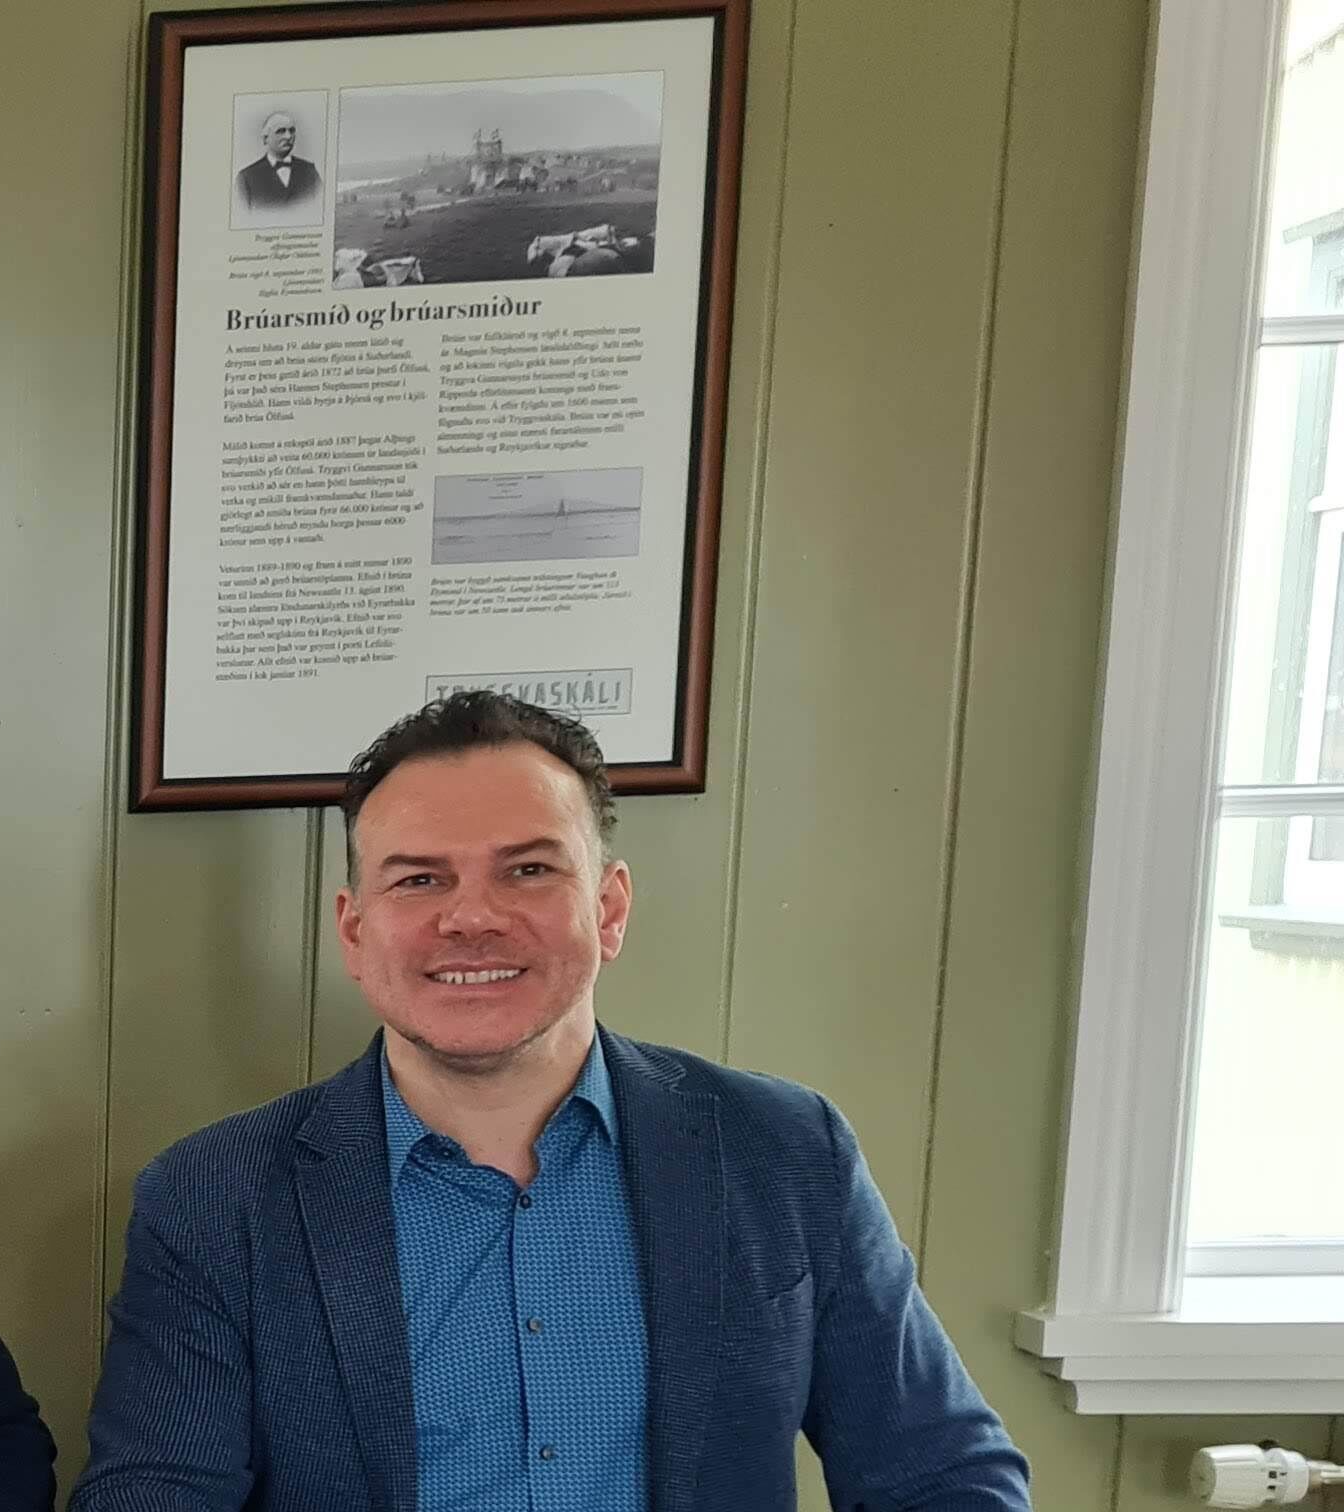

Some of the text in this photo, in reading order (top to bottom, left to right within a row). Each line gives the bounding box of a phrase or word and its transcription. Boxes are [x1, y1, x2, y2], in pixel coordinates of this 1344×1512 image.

[225, 296, 541, 330] Brúarsmíð og brúarsmiður
[436, 672, 621, 705] TVASKÁLI
